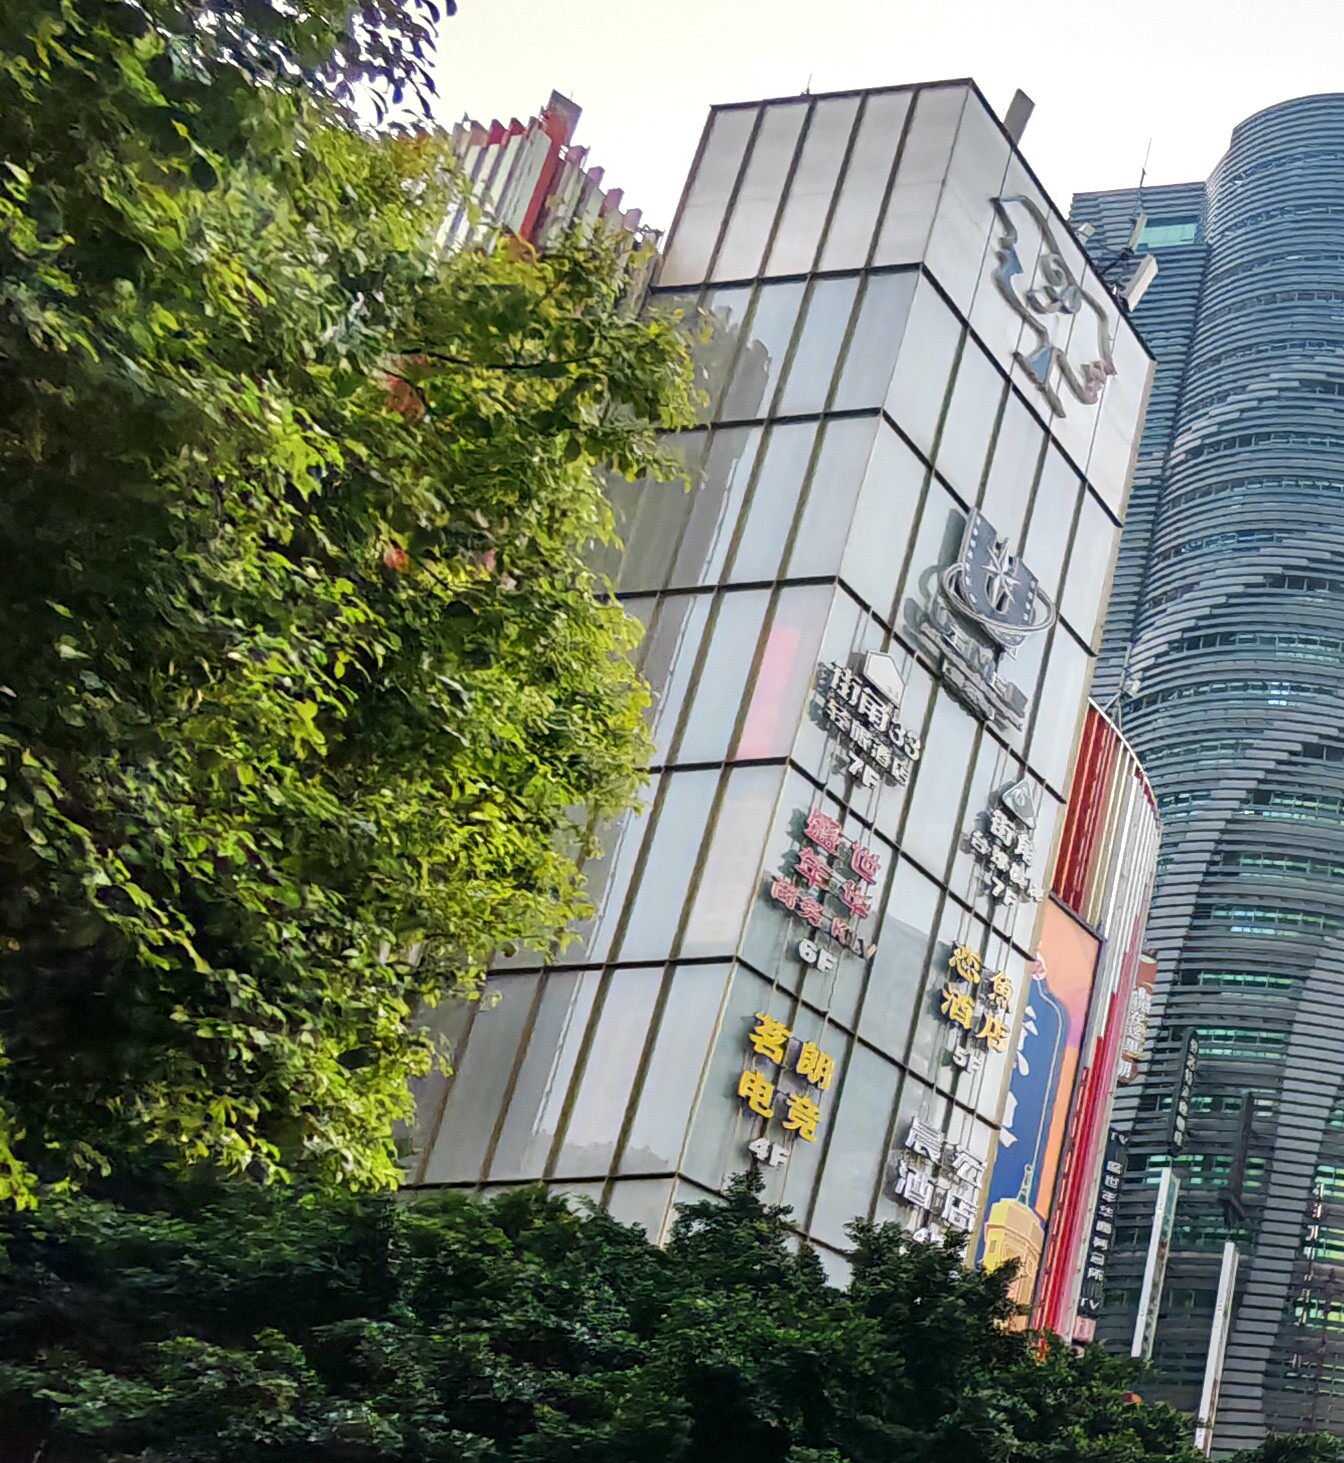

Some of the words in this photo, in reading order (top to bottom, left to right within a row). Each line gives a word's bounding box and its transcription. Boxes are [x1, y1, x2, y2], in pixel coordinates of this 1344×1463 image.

[848, 754, 880, 790] 7F
[799, 938, 838, 972] 6F
[941, 988, 1010, 1053] 酒店
[952, 1046, 983, 1074] 5F
[738, 1070, 820, 1143] 电竞
[748, 1137, 790, 1167] 4F
[895, 1159, 977, 1233] 酒店
